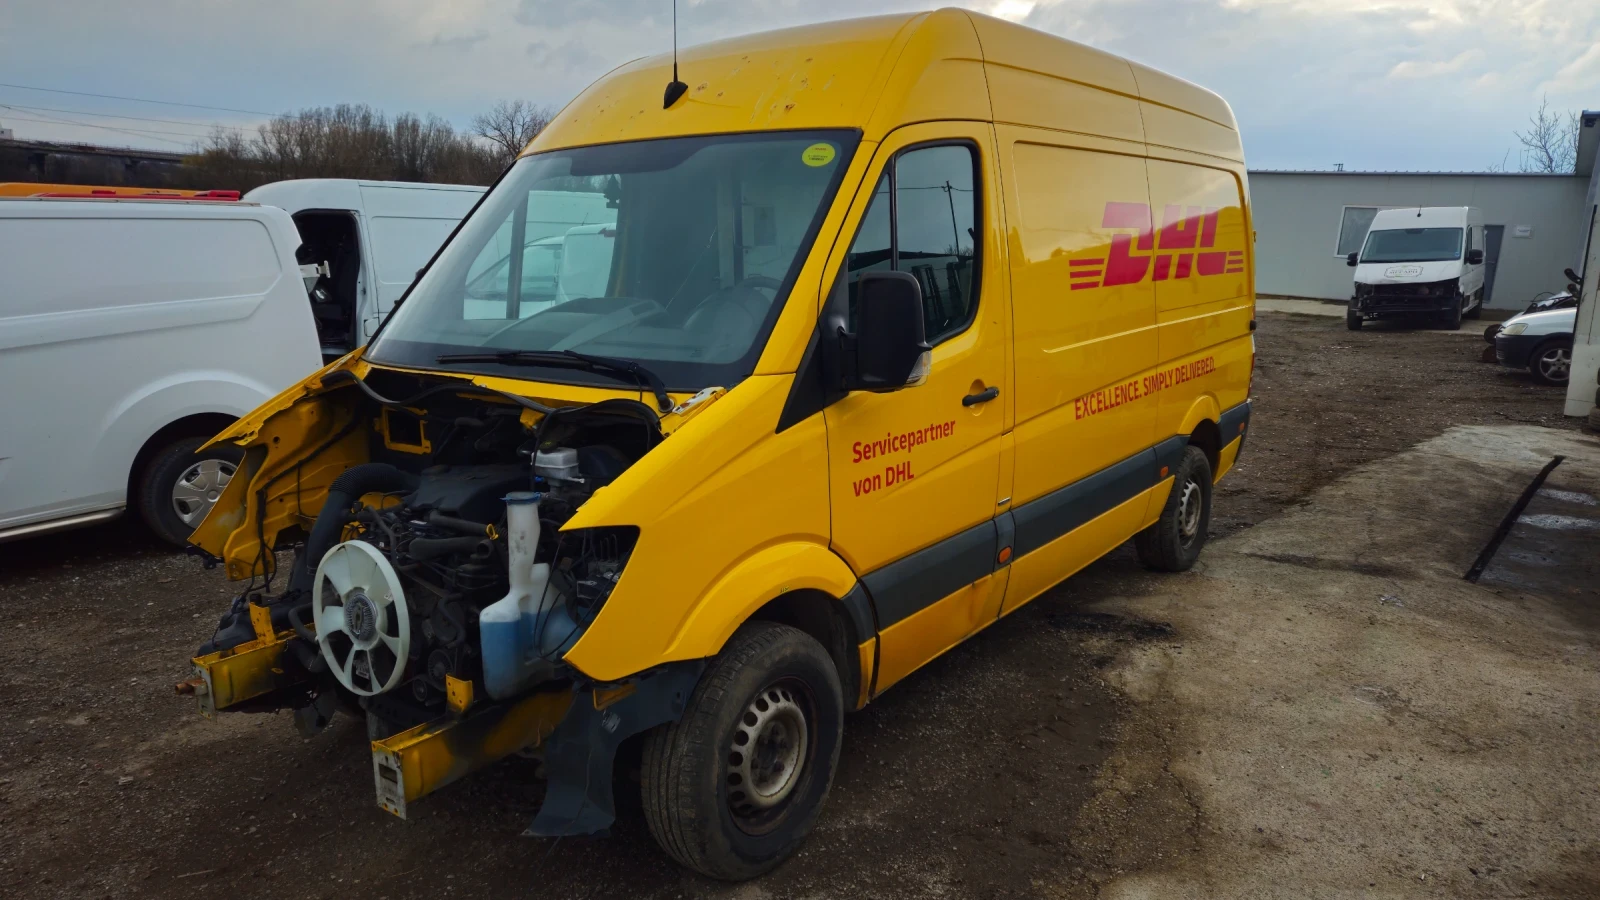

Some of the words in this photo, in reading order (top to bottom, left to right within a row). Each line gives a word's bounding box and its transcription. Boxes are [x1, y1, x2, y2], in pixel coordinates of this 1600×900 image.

[1102, 202, 1227, 287] DHL
[1075, 381, 1142, 420] EXCELLENCE.
[1143, 369, 1174, 397] SIMPLY
[1175, 356, 1216, 386] DELIVERED.
[852, 420, 956, 464] Servicepartner
[853, 474, 881, 497] von
[885, 461, 914, 487] DHL
